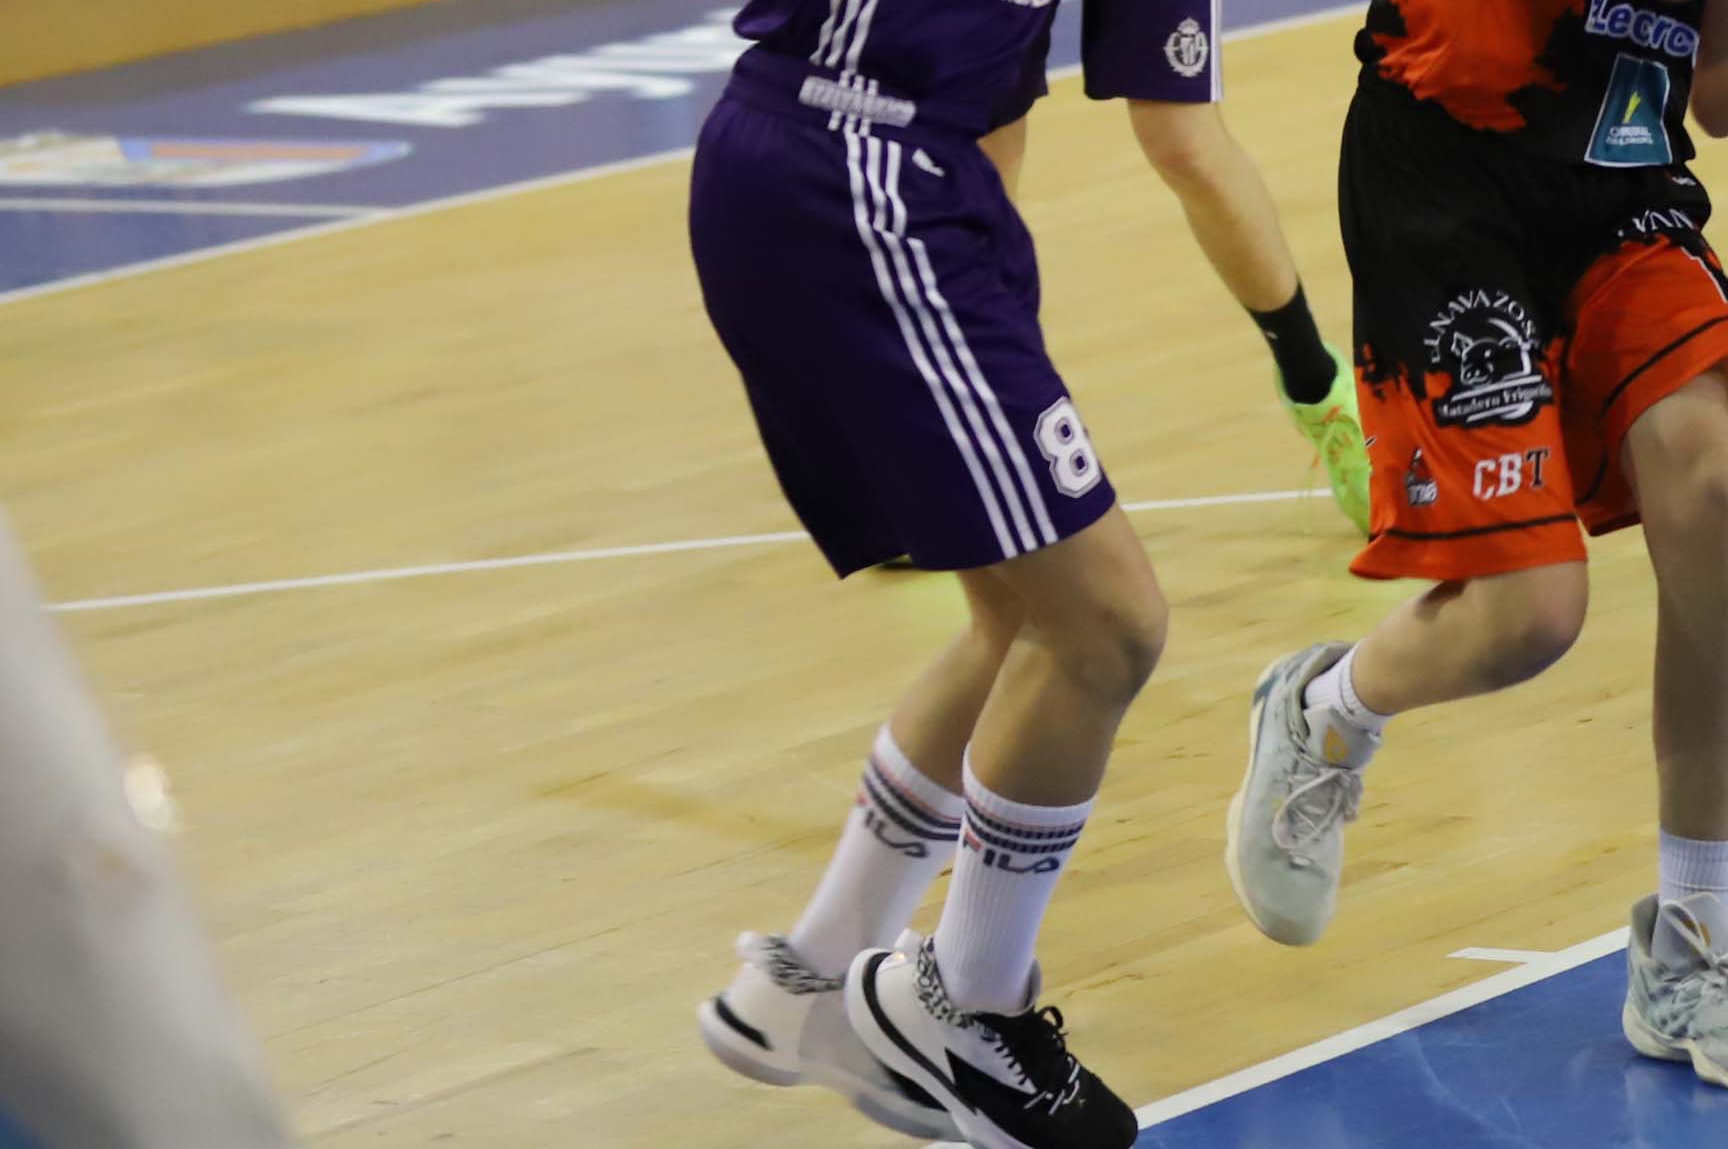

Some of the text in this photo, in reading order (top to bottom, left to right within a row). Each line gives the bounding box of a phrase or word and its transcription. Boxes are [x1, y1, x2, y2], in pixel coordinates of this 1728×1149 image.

[1033, 395, 1101, 499] 8
[1472, 447, 1549, 500] CBT
[963, 828, 1060, 874] FILA
